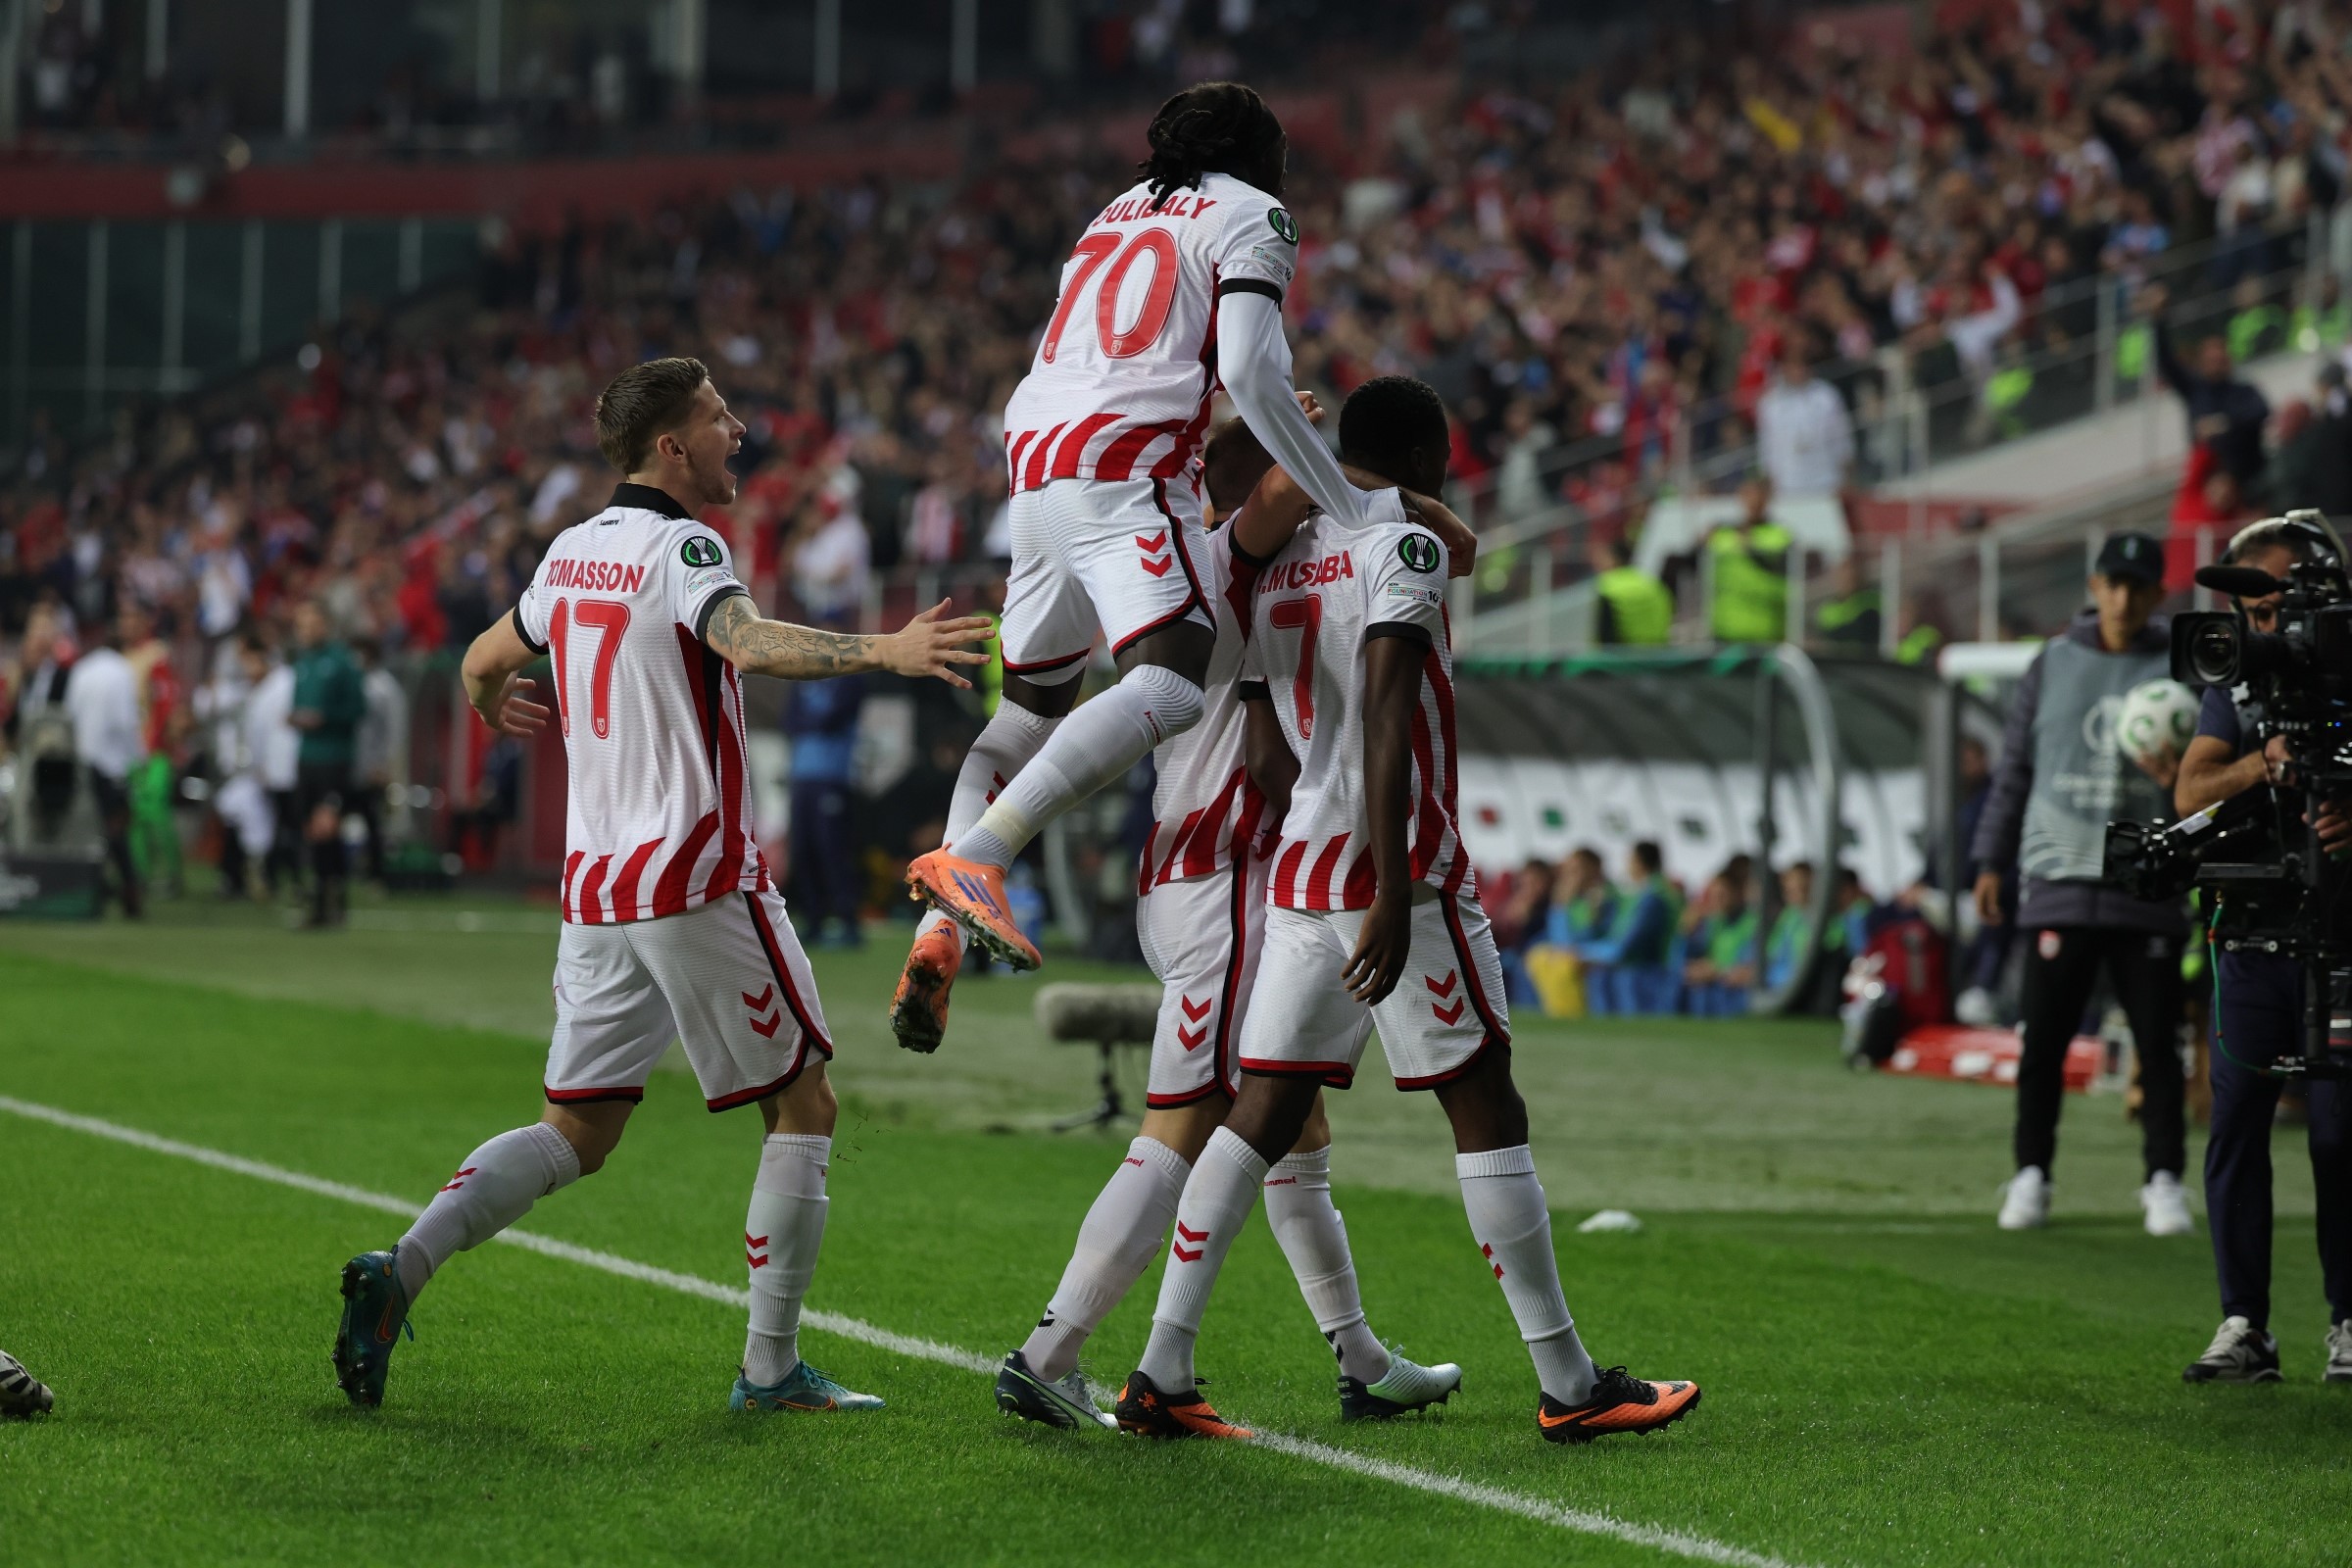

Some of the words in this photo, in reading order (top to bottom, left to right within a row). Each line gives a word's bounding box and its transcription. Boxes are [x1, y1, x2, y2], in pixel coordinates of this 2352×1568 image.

[1092, 196, 1217, 227] OULIBALY
[1043, 227, 1179, 364] 70
[549, 597, 631, 740] 17
[1270, 593, 1322, 740] 7
[1263, 1175, 1297, 1186] ummel
